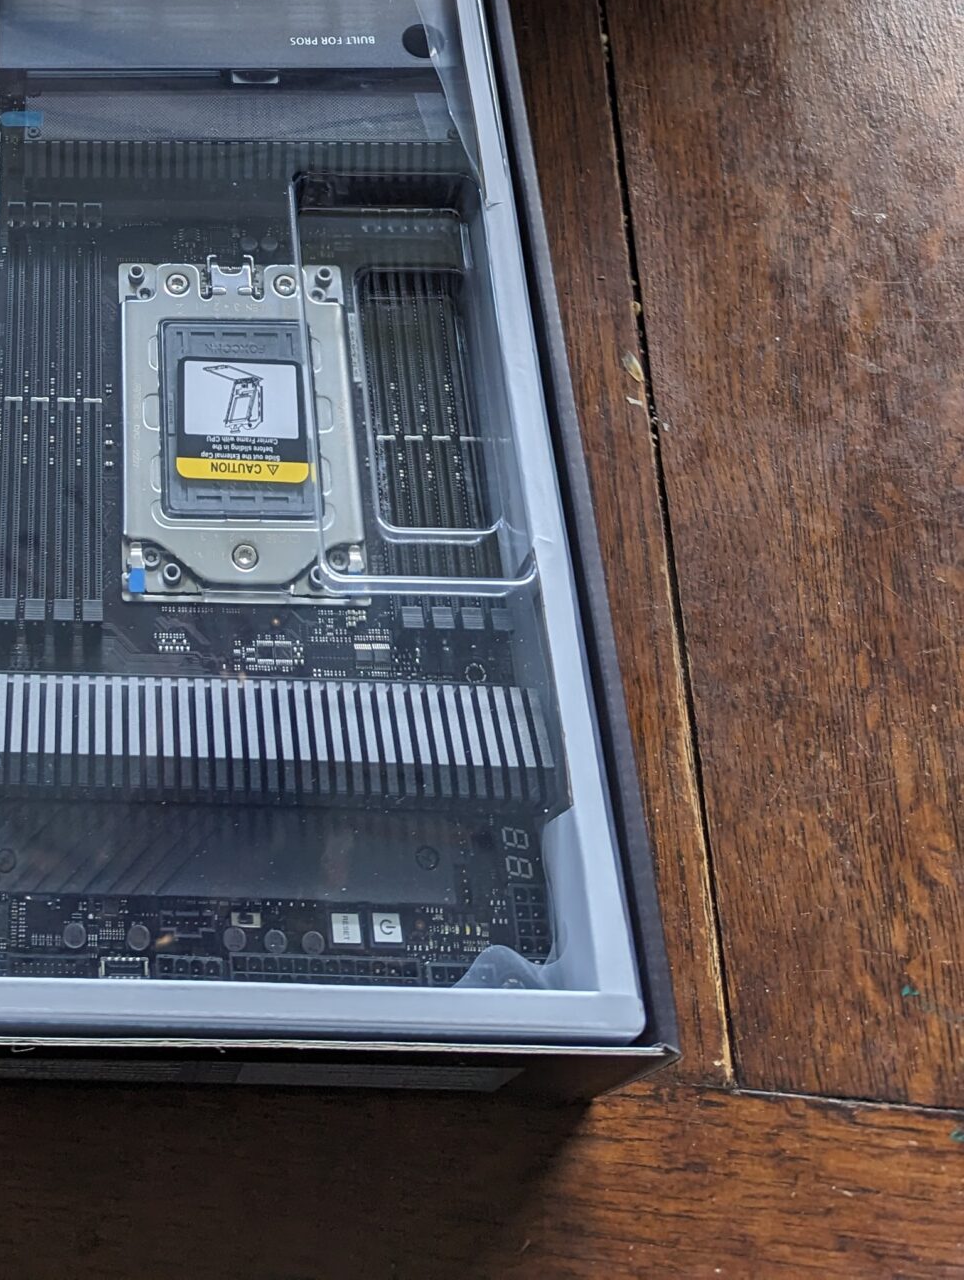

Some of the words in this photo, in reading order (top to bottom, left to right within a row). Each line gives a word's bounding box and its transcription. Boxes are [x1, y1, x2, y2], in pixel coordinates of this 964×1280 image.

[289, 36, 318, 46] PROS
[321, 36, 343, 45] FOR
[345, 35, 376, 45] BUILT
[236, 436, 256, 444] Frame
[256, 437, 279, 445] Carrier
[212, 443, 223, 451] the
[223, 443, 230, 451] in
[231, 443, 253, 452] sliding
[253, 445, 274, 453] before
[200, 450, 214, 459] Cap
[215, 452, 239, 460] External
[265, 454, 281, 462] Slide
[210, 462, 262, 475] CAUTION
[341, 915, 350, 940] RESET
